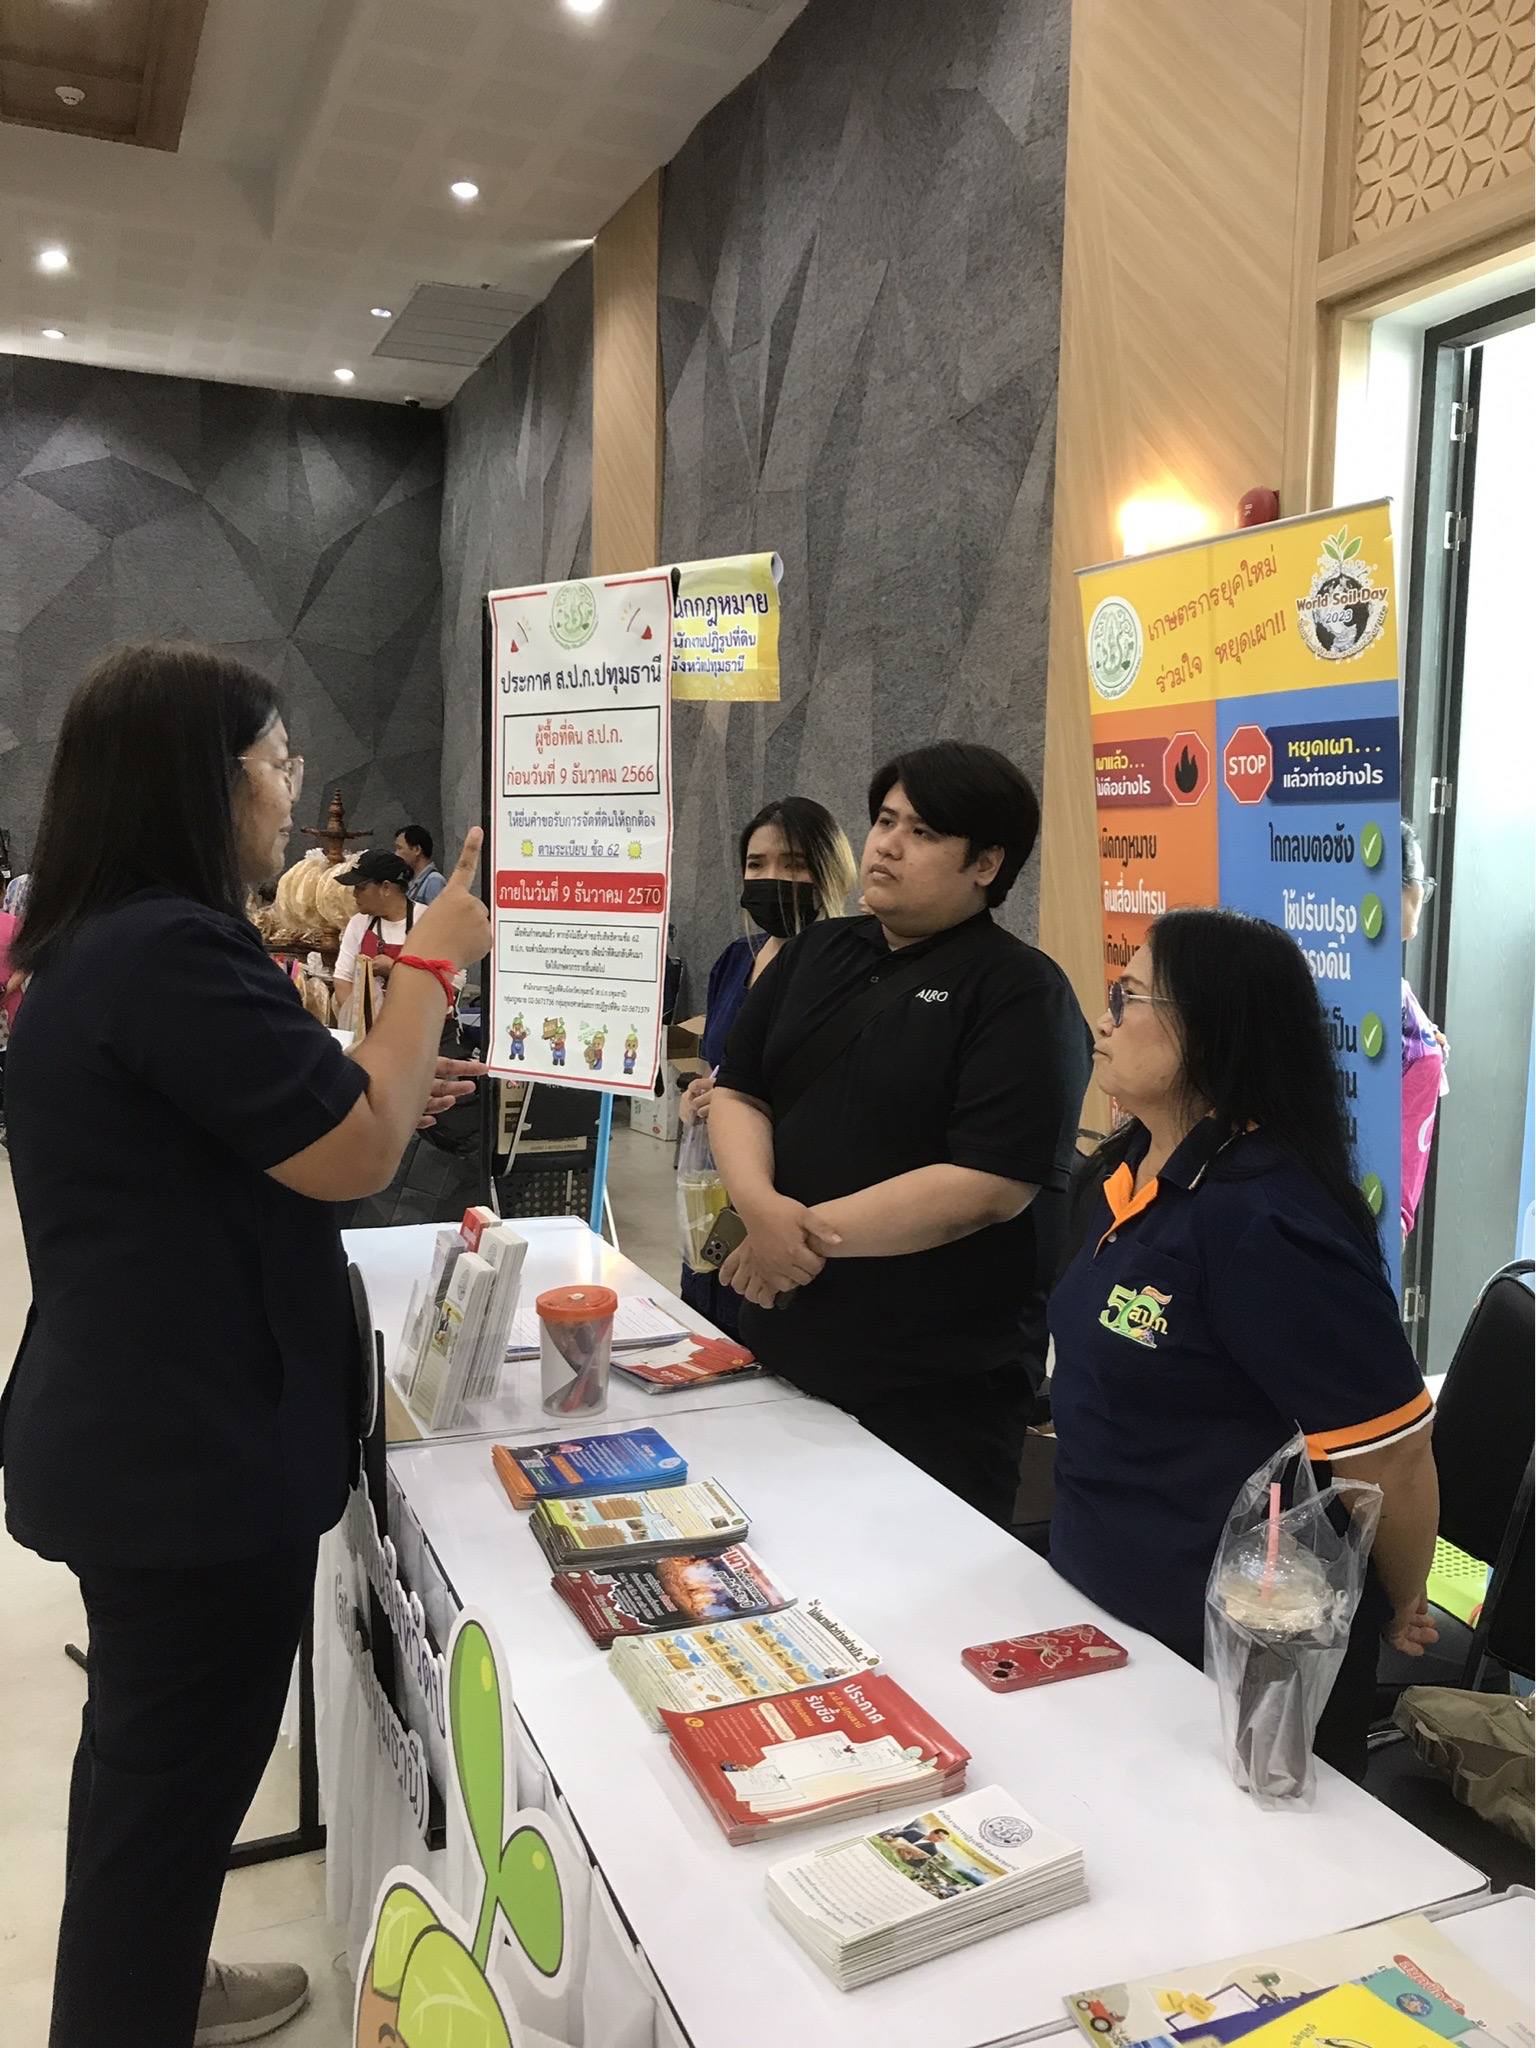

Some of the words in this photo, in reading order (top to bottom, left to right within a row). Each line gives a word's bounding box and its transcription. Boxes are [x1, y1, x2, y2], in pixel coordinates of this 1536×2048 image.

[1148, 544, 1277, 641] เกษตรกรยุคใหม่
[1297, 595, 1328, 611] World
[1333, 590, 1356, 605] Soil
[1361, 588, 1387, 601] Day
[1326, 611, 1353, 624] 2023
[672, 626, 757, 654] นักงานปฏิรูปที่ดิน
[501, 671, 551, 694] ประกาศ
[555, 654, 661, 694] ส.ป.ก.ปทุมธานี
[1156, 653, 1203, 693] ร่วมใจ
[535, 718, 583, 754] ผู้ซื้อที่ดิน
[587, 724, 624, 745] ส.ป.ก.
[507, 758, 556, 786] ก่อนวันที่
[560, 767, 568, 785] 9
[572, 762, 617, 785] ธันวาคม
[621, 765, 655, 784] 2566
[1229, 754, 1267, 776] STOP
[1283, 763, 1385, 788] แล้วทำอย่างไร
[538, 839, 588, 857] ตามระเบียบ
[591, 839, 604, 857] ข้อ
[607, 843, 620, 857] 62
[500, 876, 559, 901] ภายในวันที่
[562, 885, 571, 902] 9
[574, 880, 623, 904] ธันวาคม
[627, 887, 662, 905] 2570
[1104, 871, 1167, 915] ดินเสื่อมโทรม
[1283, 889, 1358, 945] ใช้ปรับปรุง
[915, 989, 949, 1003] ALRO
[804, 1695, 841, 1724] รับซื้อ
[843, 1683, 886, 1725] ประกาศ
